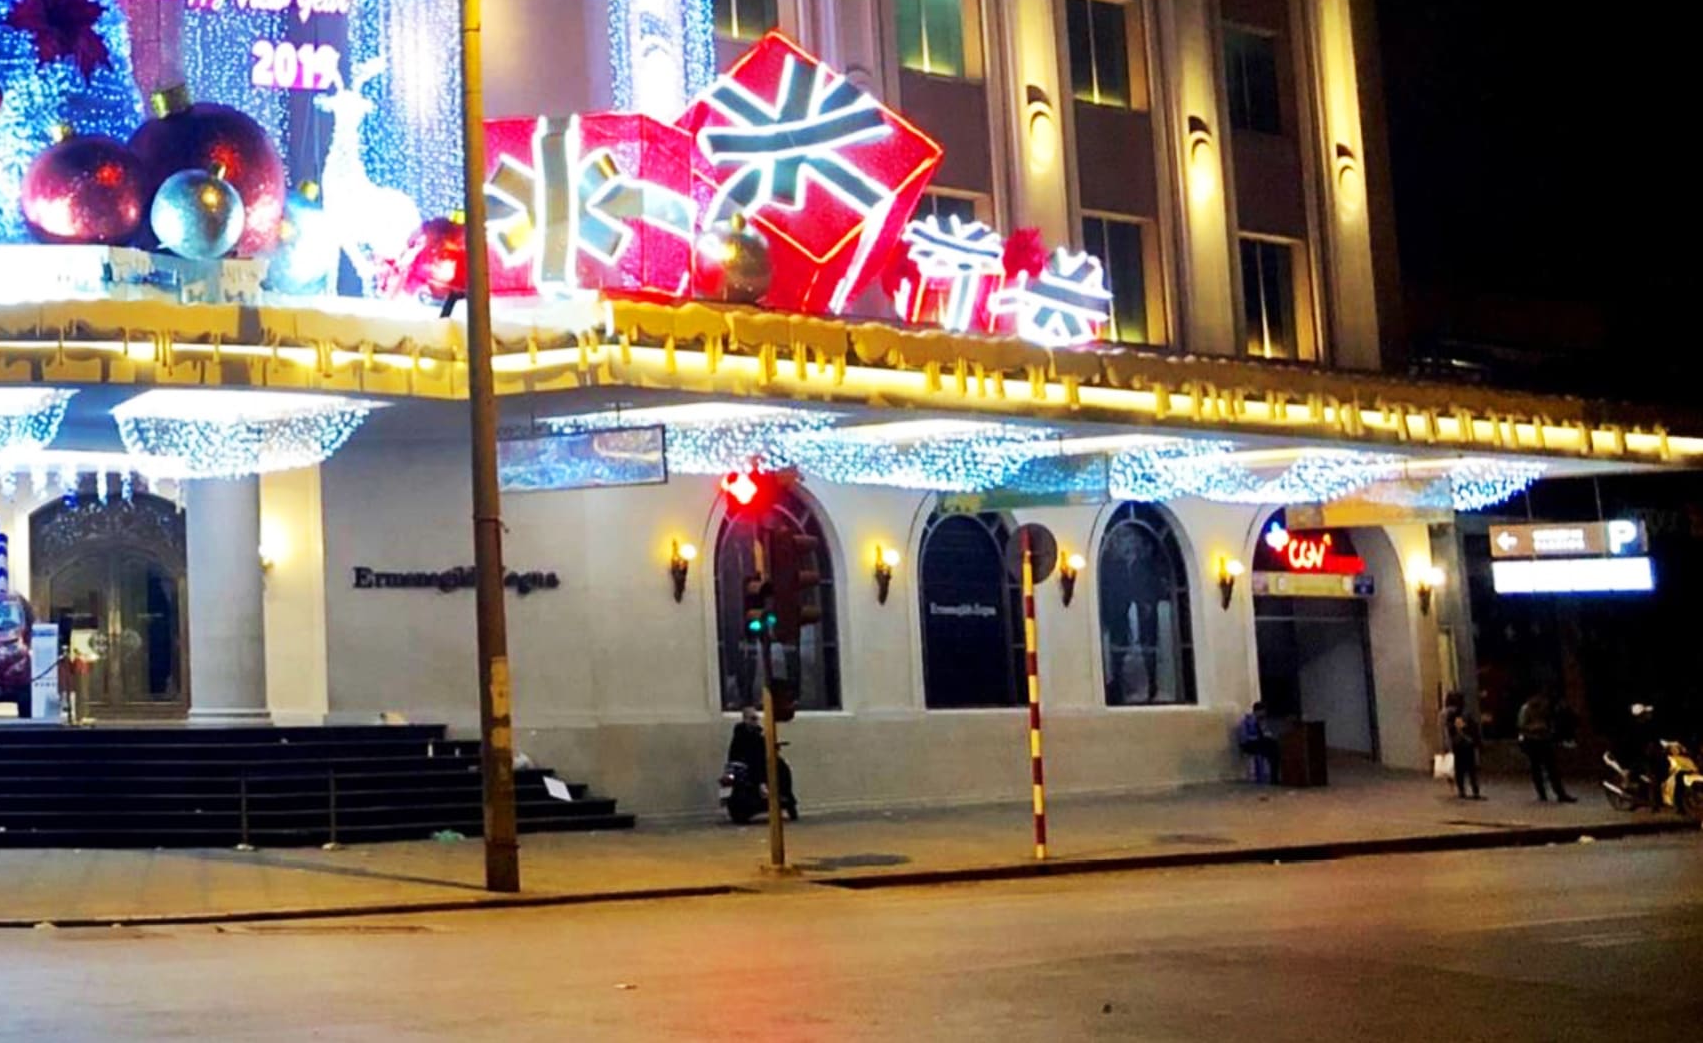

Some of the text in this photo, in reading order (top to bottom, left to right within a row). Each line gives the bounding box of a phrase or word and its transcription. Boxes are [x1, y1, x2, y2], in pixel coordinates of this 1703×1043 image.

[251, 39, 339, 90] 2019
[1288, 538, 1326, 570] CGV
[1608, 519, 1637, 555] P
